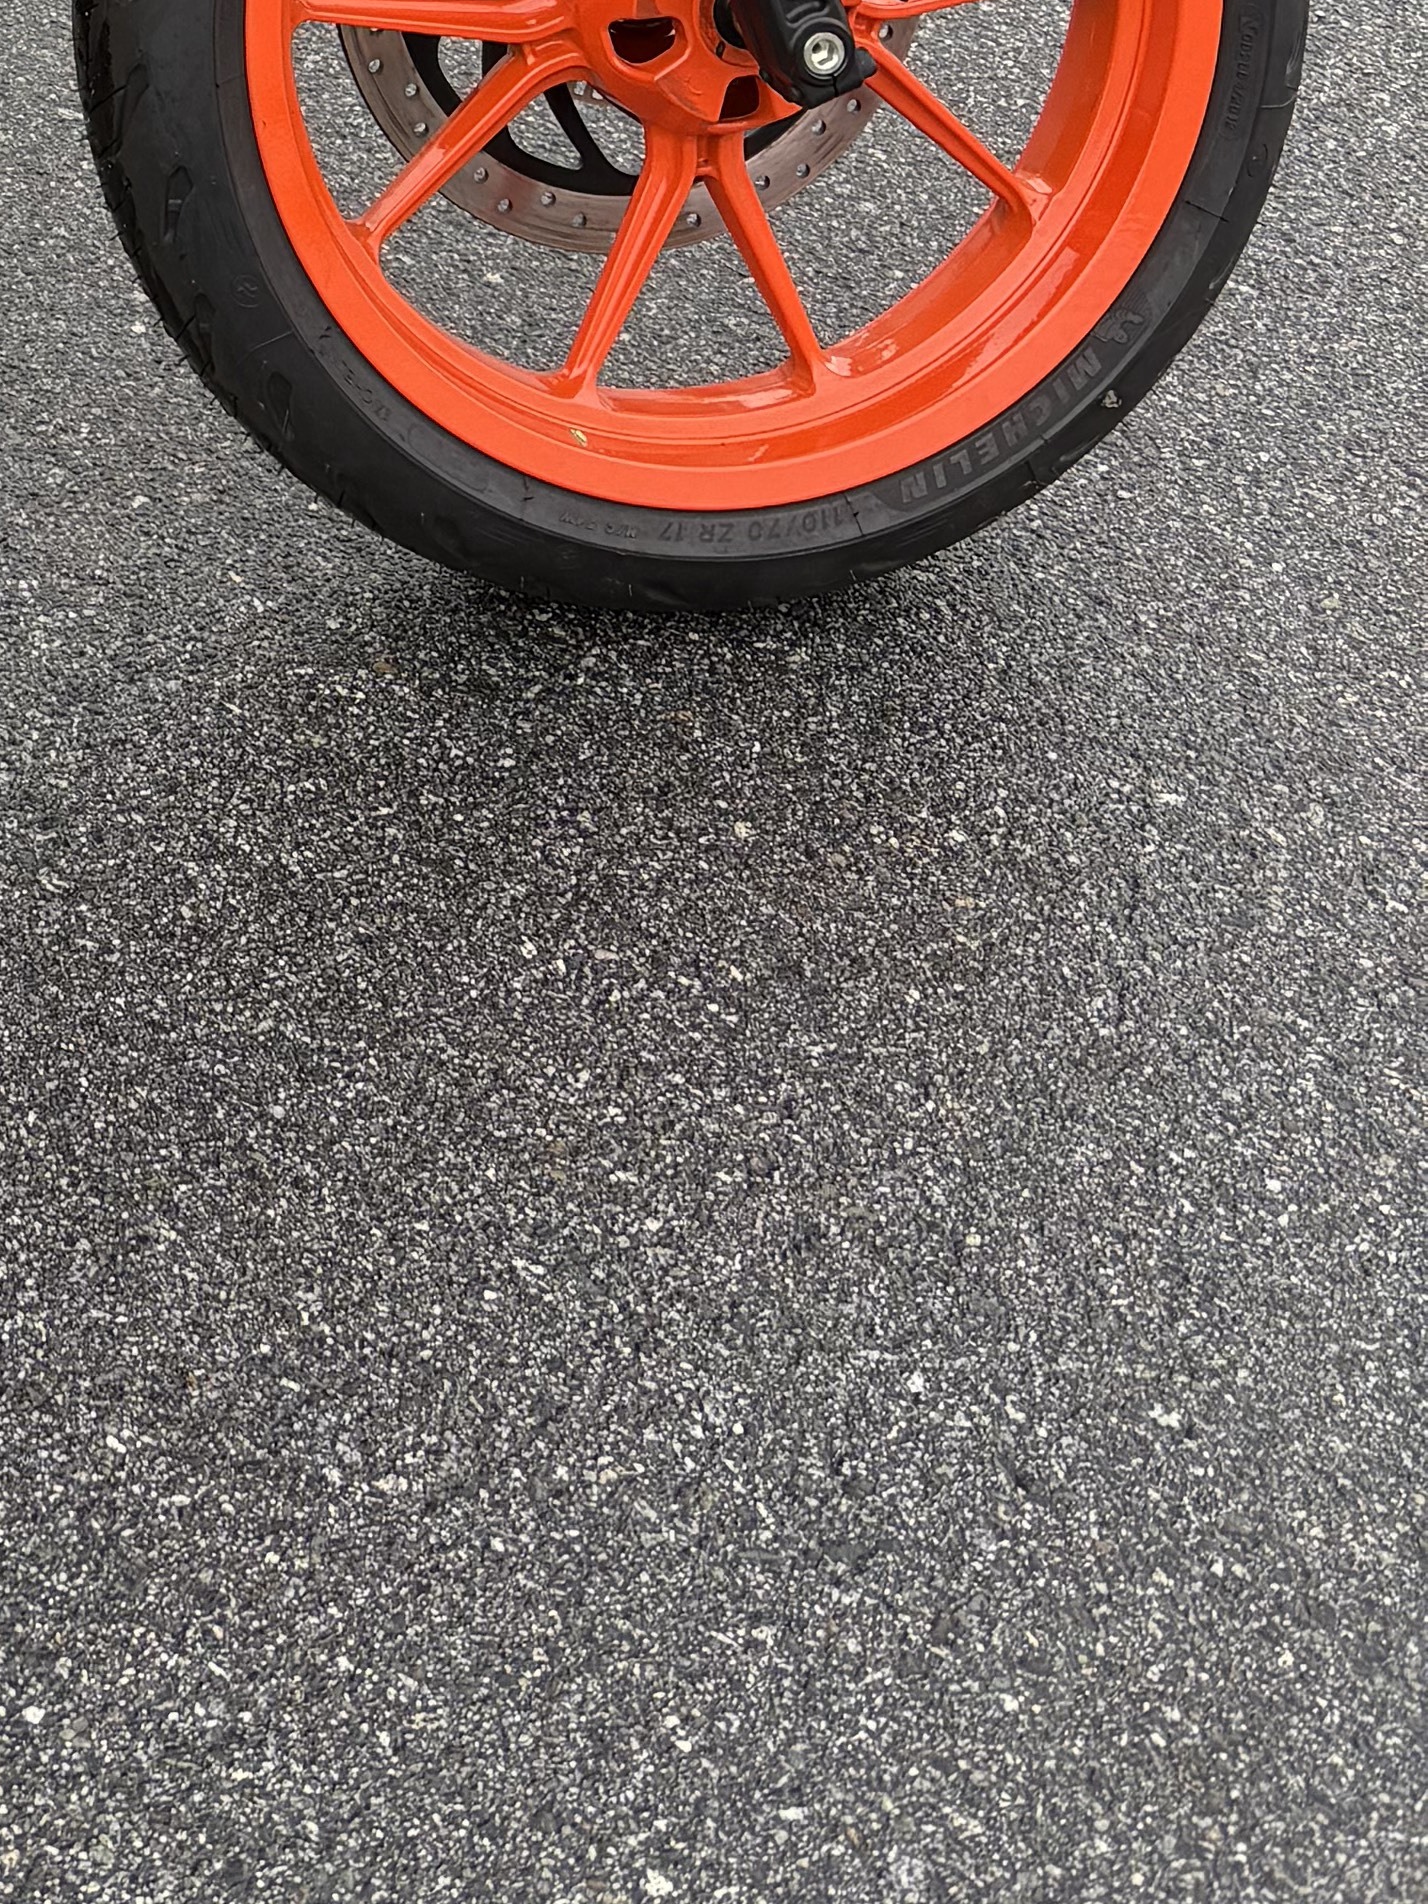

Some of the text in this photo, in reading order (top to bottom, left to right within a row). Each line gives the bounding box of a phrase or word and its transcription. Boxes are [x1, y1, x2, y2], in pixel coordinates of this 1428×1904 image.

[893, 344, 1109, 506] MICHELIN
[657, 521, 683, 542] 17
[698, 521, 735, 543] ZR
